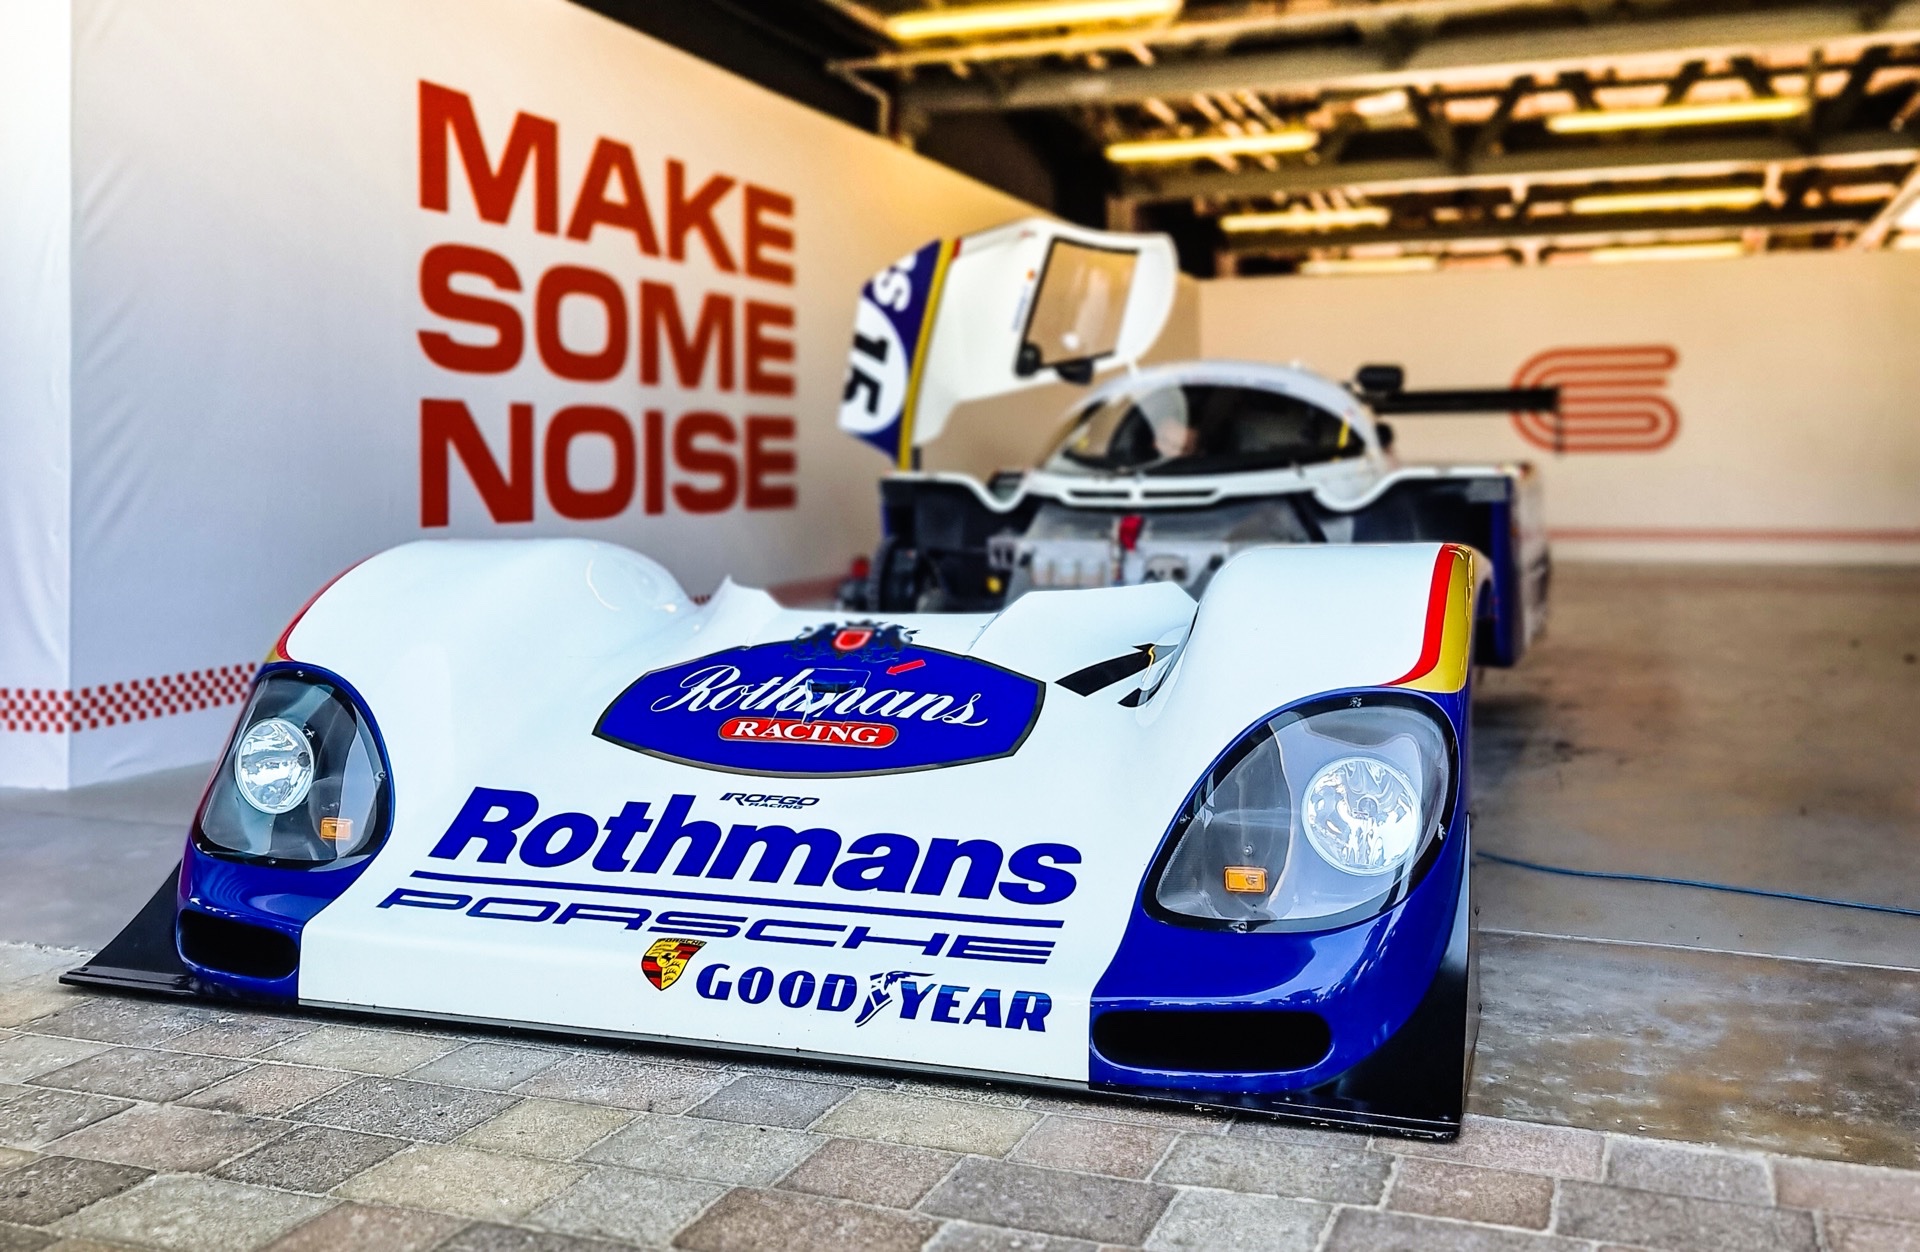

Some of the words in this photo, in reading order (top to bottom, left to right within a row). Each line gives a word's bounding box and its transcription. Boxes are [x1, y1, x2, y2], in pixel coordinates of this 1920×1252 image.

[417, 78, 798, 288] MAKE
[416, 242, 798, 398] SOME
[420, 398, 798, 527] NOISE
[651, 665, 988, 727] Rothmans
[731, 720, 880, 743] RACING
[427, 786, 1081, 906] Rothmans
[748, 802, 803, 810] RACING
[376, 887, 1057, 965] PORSCHE
